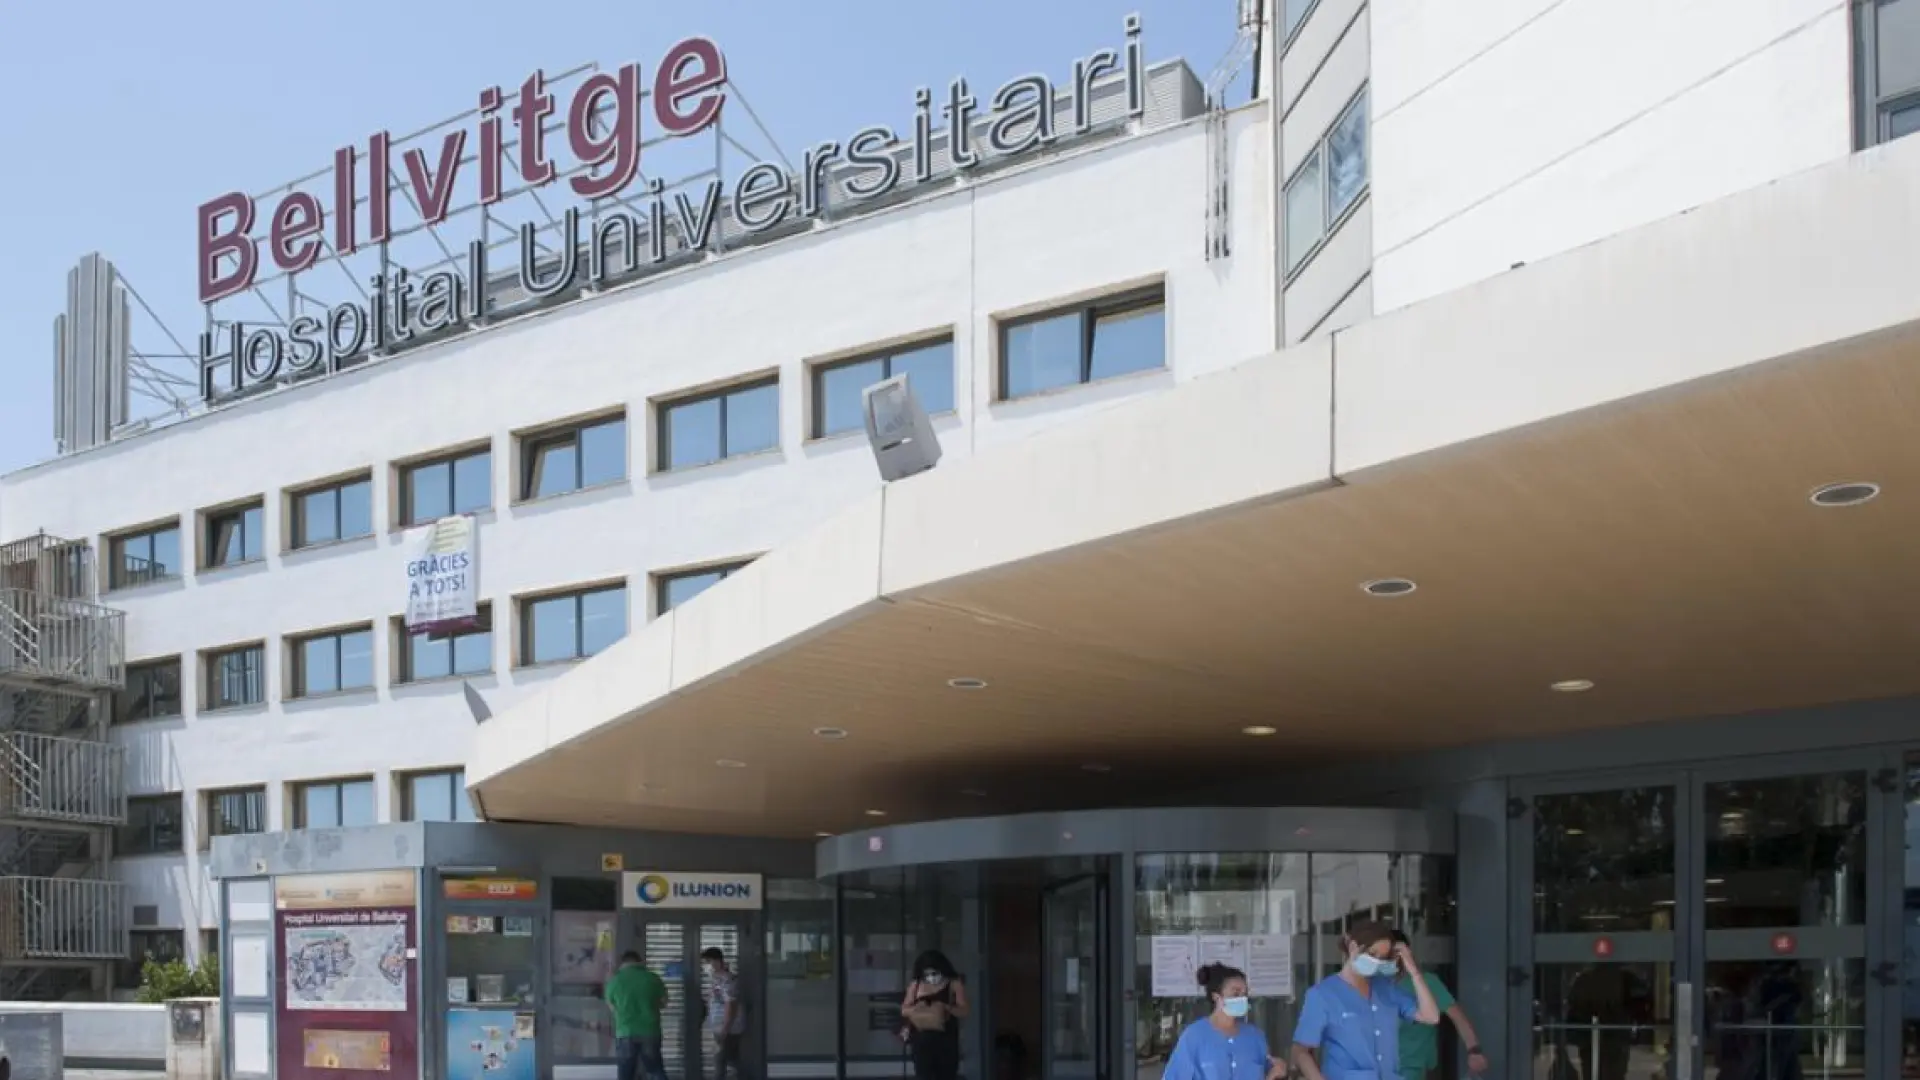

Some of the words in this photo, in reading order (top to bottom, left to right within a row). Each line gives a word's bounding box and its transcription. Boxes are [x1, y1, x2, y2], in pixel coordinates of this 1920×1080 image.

[198, 37, 728, 302] Bellvitge
[200, 240, 484, 402] Hospital
[520, 13, 1144, 298] Universitari
[410, 580, 420, 598] A
[424, 574, 466, 596] TOTS!
[672, 882, 750, 897] ILUNION
[283, 912, 314, 926] Hospital
